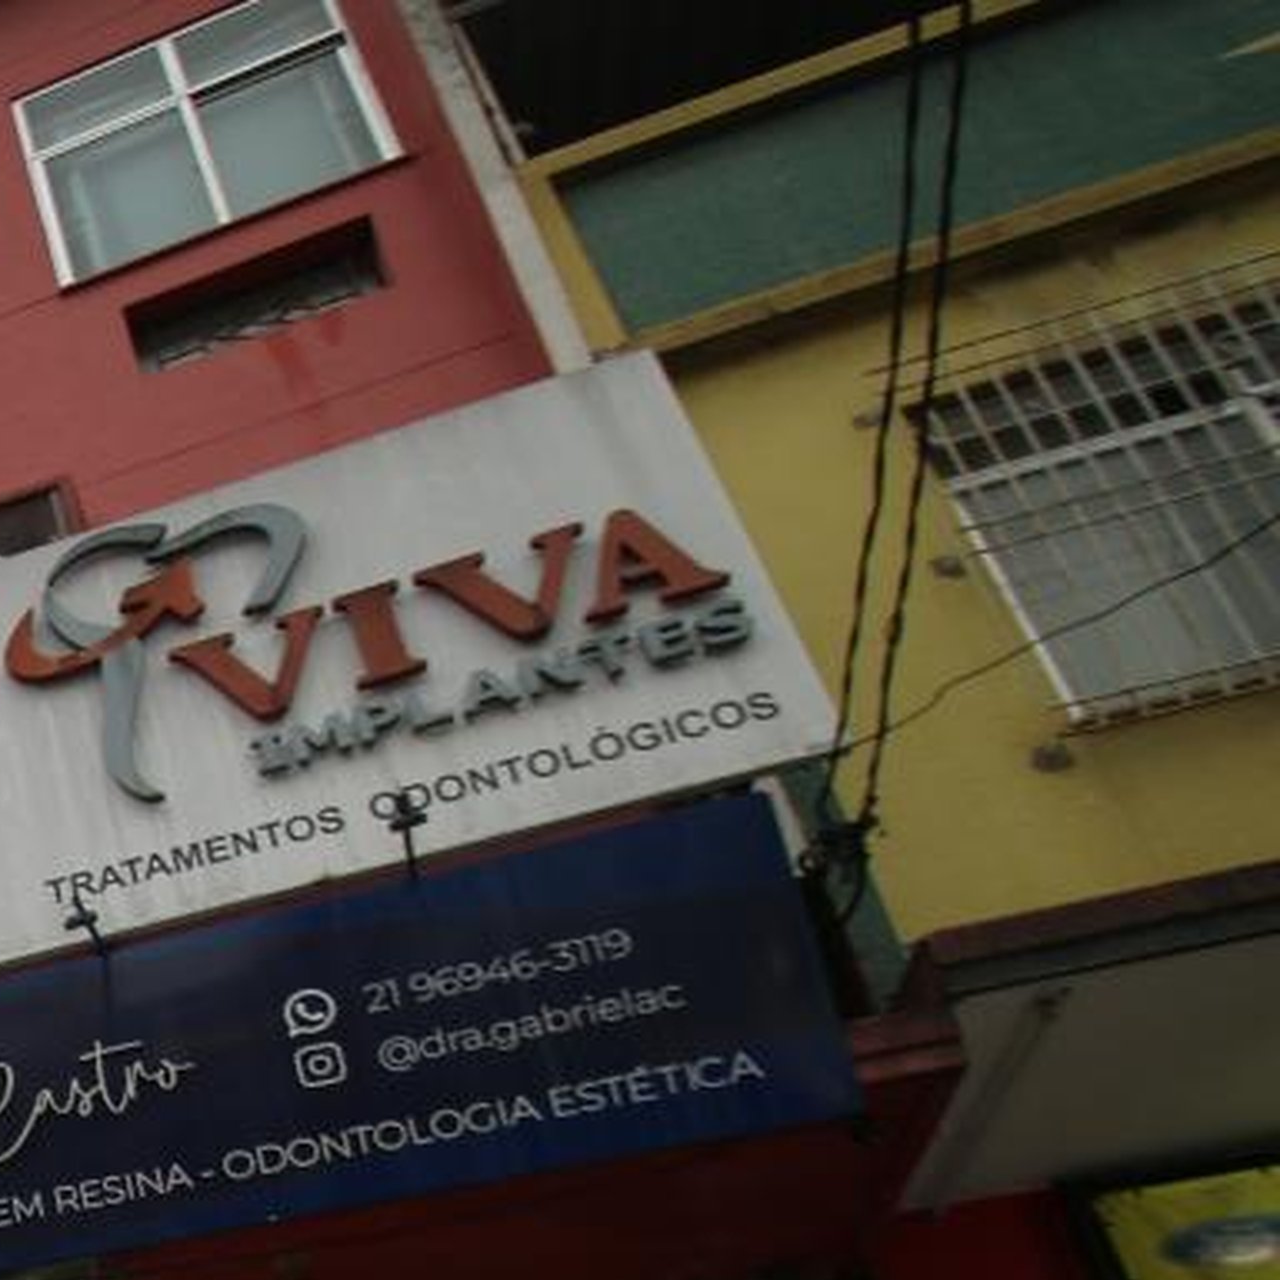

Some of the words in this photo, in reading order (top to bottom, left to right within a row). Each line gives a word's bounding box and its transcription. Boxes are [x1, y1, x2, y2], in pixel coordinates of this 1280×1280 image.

[167, 509, 731, 722] VIVA
[247, 602, 757, 781] IMPLANTES
[46, 804, 346, 910] TRATAMENTOS
[369, 690, 782, 824] ODONTOLÓGICOS
[363, 980, 404, 1014] 21
[411, 927, 633, 1001] 96946-3119
[377, 982, 687, 1073] @dra.gabrielac
[53, 1161, 194, 1214] RESINA
[222, 1096, 542, 1181] ODONTOLOGIA
[548, 1050, 767, 1119] ESTÉTICA
